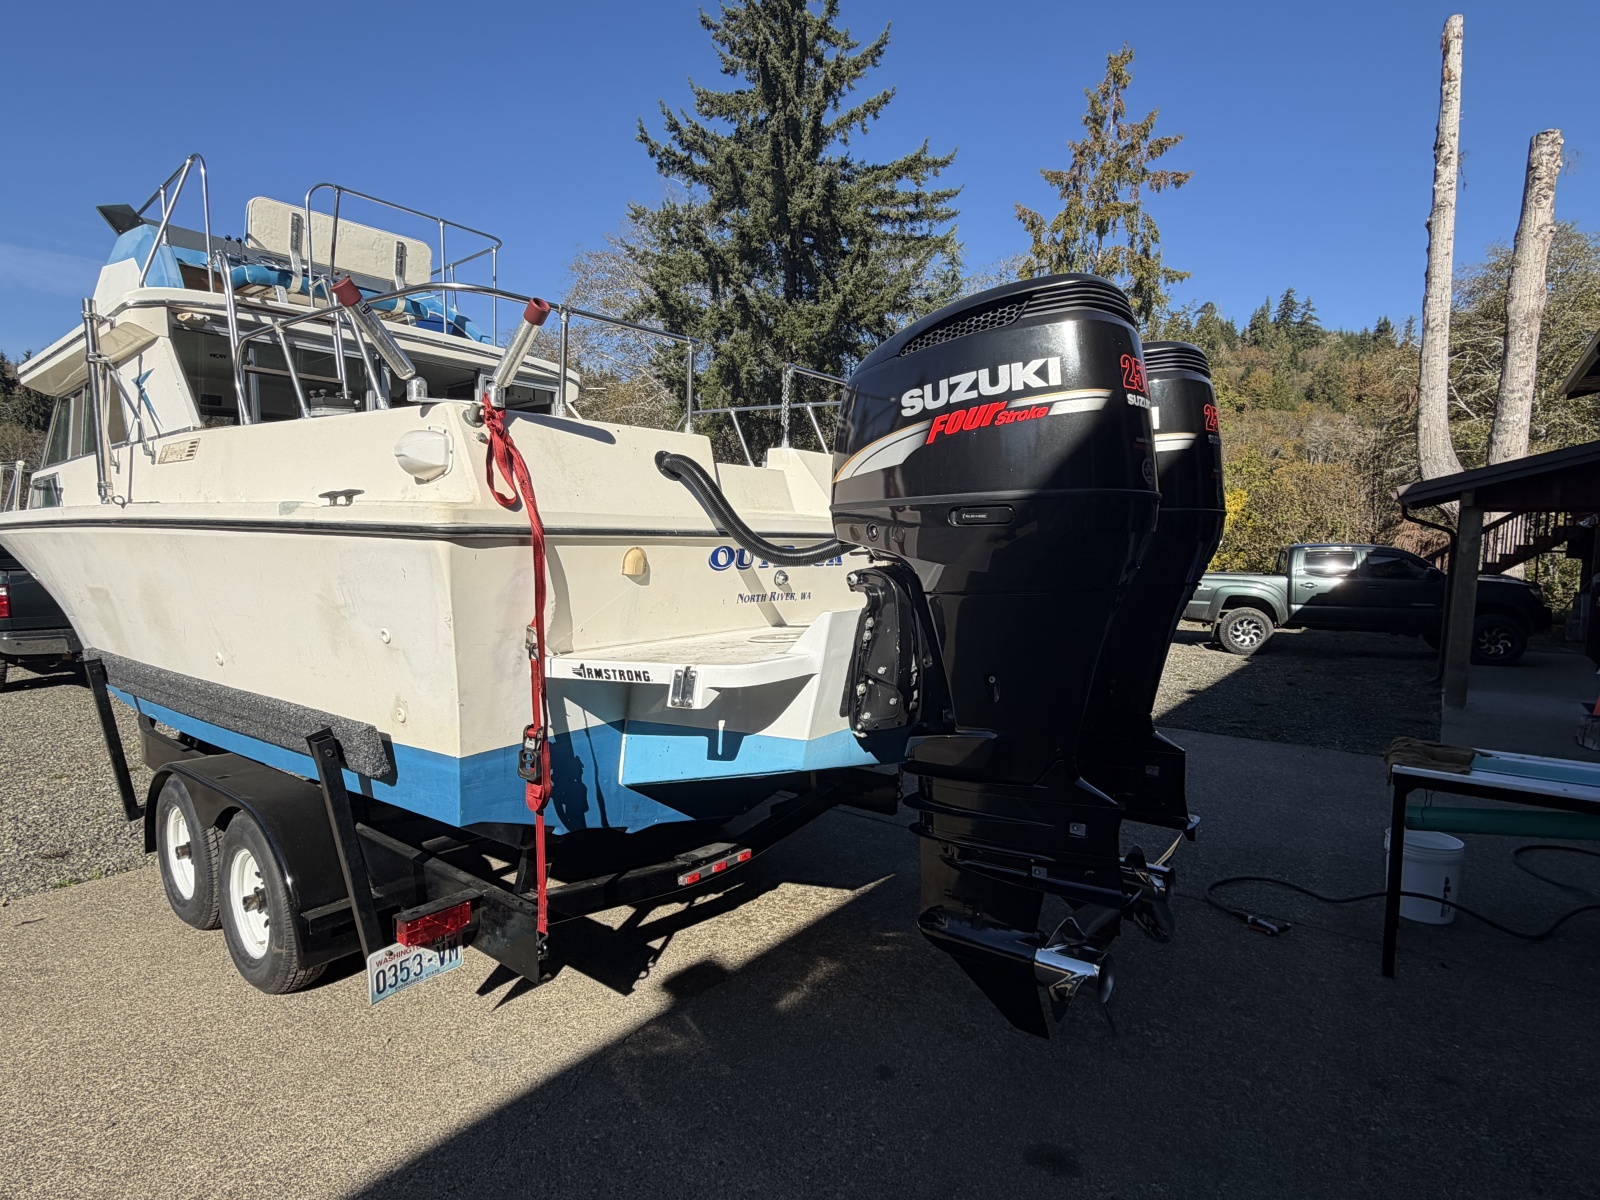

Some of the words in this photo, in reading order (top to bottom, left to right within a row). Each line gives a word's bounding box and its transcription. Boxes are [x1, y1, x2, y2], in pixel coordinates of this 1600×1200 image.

[901, 357, 1062, 417] SUZUKI
[736, 592, 767, 604] NORTH
[769, 591, 798, 602] RIVER,
[800, 591, 812, 600] WA
[572, 663, 651, 682] ARMSTRONG
